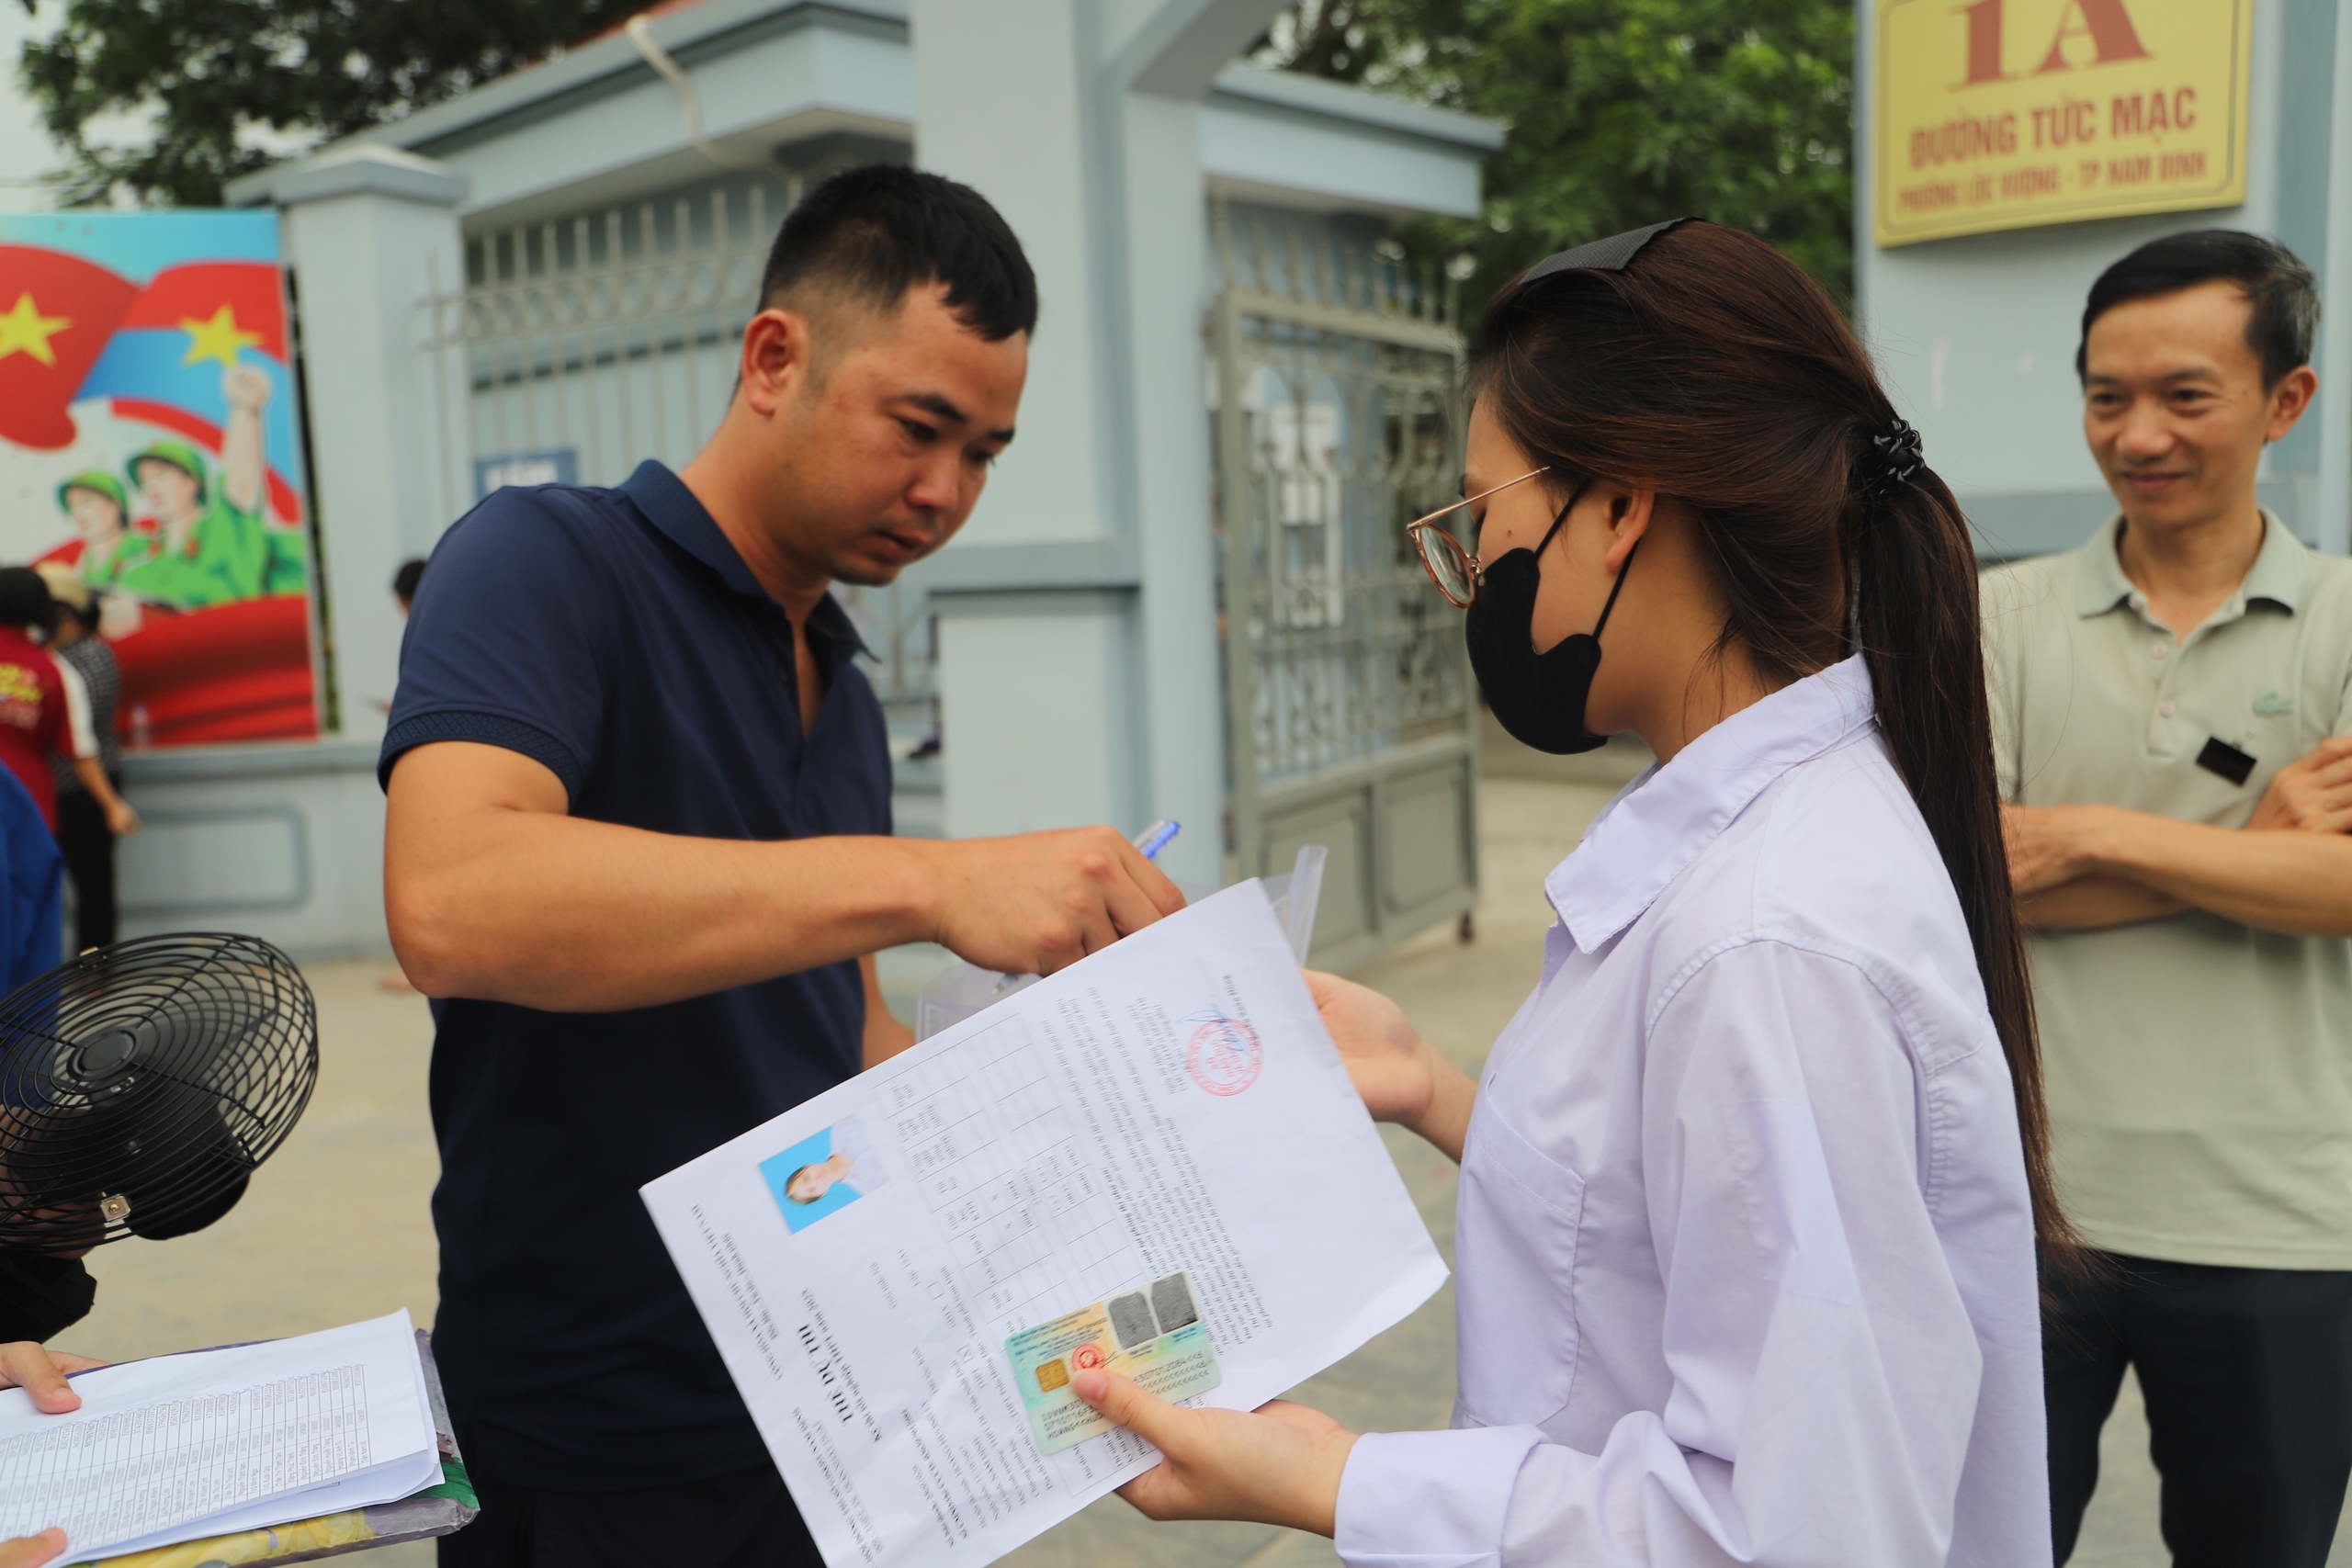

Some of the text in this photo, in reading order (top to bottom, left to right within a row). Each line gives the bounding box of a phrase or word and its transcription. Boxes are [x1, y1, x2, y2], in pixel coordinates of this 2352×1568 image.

[1946, 0, 2156, 92] 1A
[1909, 105, 2018, 170] ĐƯỜNG
[2111, 86, 2197, 142] MẠC
[794, 1323, 859, 1428] THẺ DỰ THI
